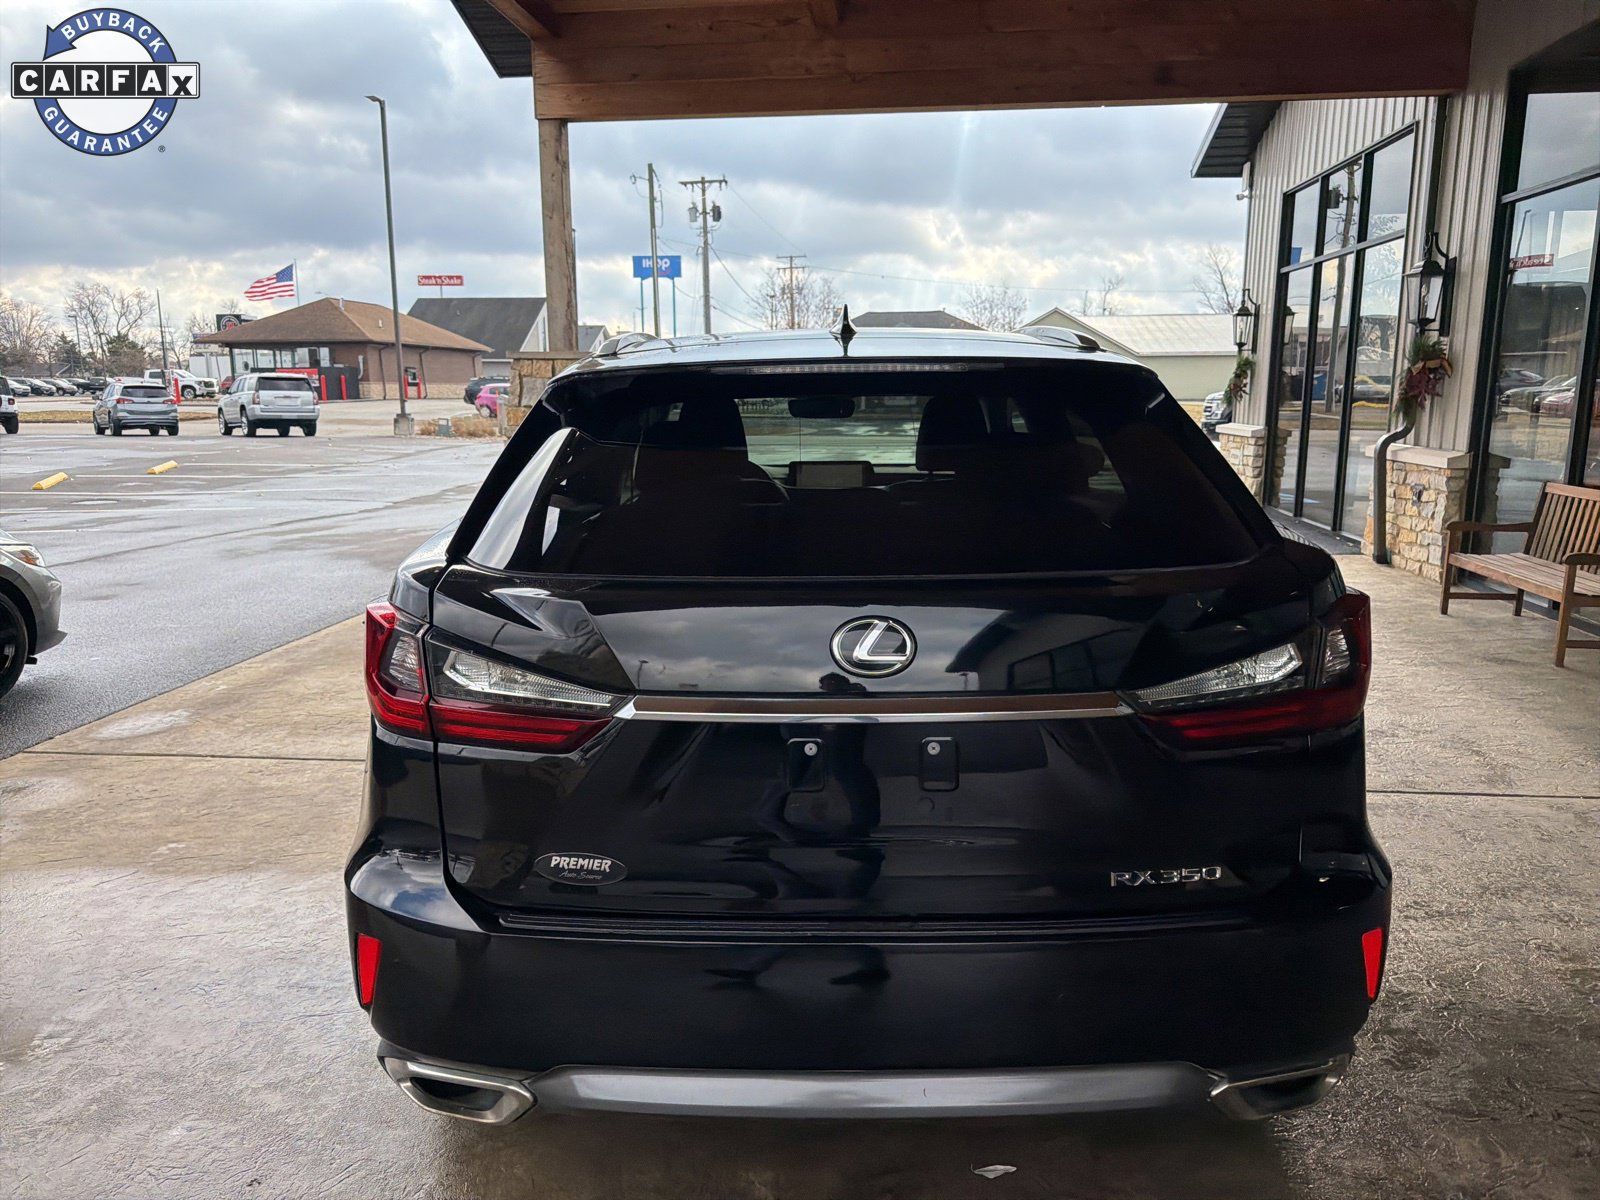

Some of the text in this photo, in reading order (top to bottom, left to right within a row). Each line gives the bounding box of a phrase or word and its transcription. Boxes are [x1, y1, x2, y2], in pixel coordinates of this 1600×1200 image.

[550, 856, 612, 872] PREMIER
[560, 870, 602, 880] Auto Source
[1110, 866, 1221, 887] RX 350
